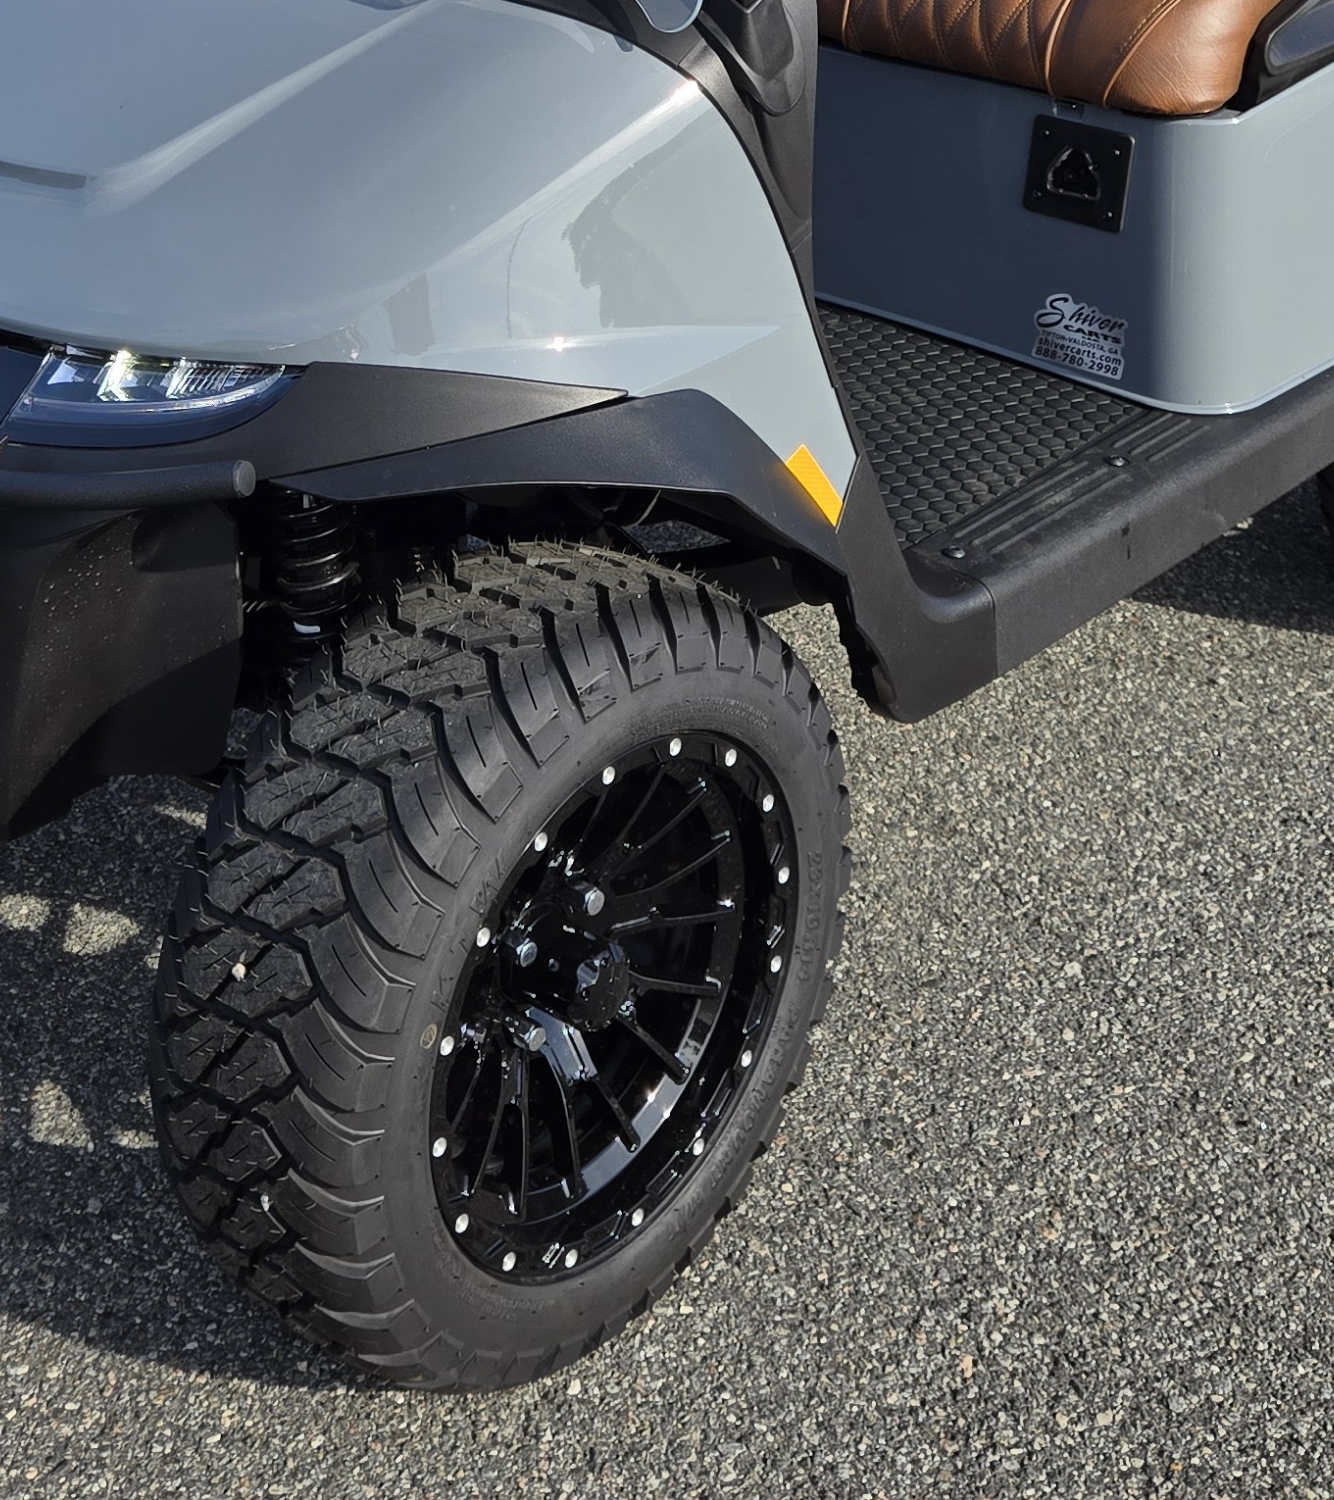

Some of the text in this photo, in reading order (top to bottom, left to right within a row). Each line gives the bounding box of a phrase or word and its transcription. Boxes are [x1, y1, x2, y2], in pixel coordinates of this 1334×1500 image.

[1036, 296, 1125, 333] Shiver
[1063, 324, 1122, 344] CARTS
[1035, 346, 1119, 377] 888-780-2998
[1037, 338, 1122, 367] shivercarts.com
[1107, 347, 1119, 355] GA
